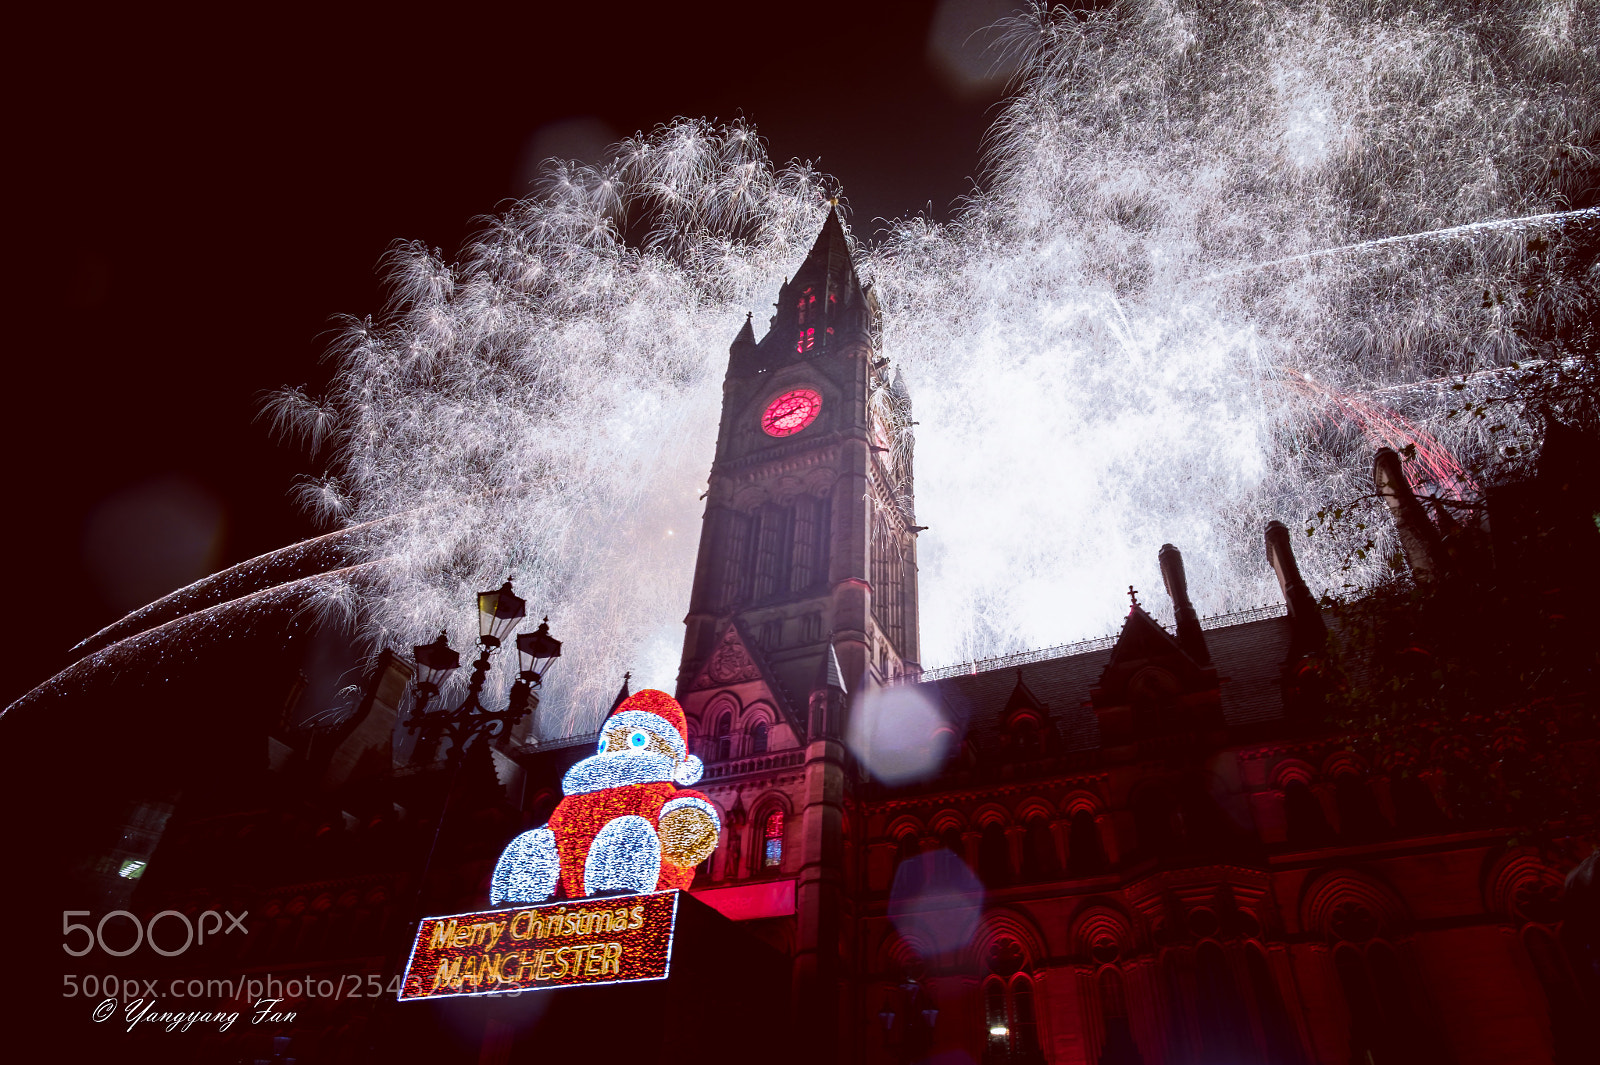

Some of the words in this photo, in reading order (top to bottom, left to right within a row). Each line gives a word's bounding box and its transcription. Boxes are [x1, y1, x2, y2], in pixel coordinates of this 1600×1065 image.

[429, 919, 506, 952] Merry
[510, 906, 645, 941] Christmas
[433, 942, 623, 990] MANCHESTER
